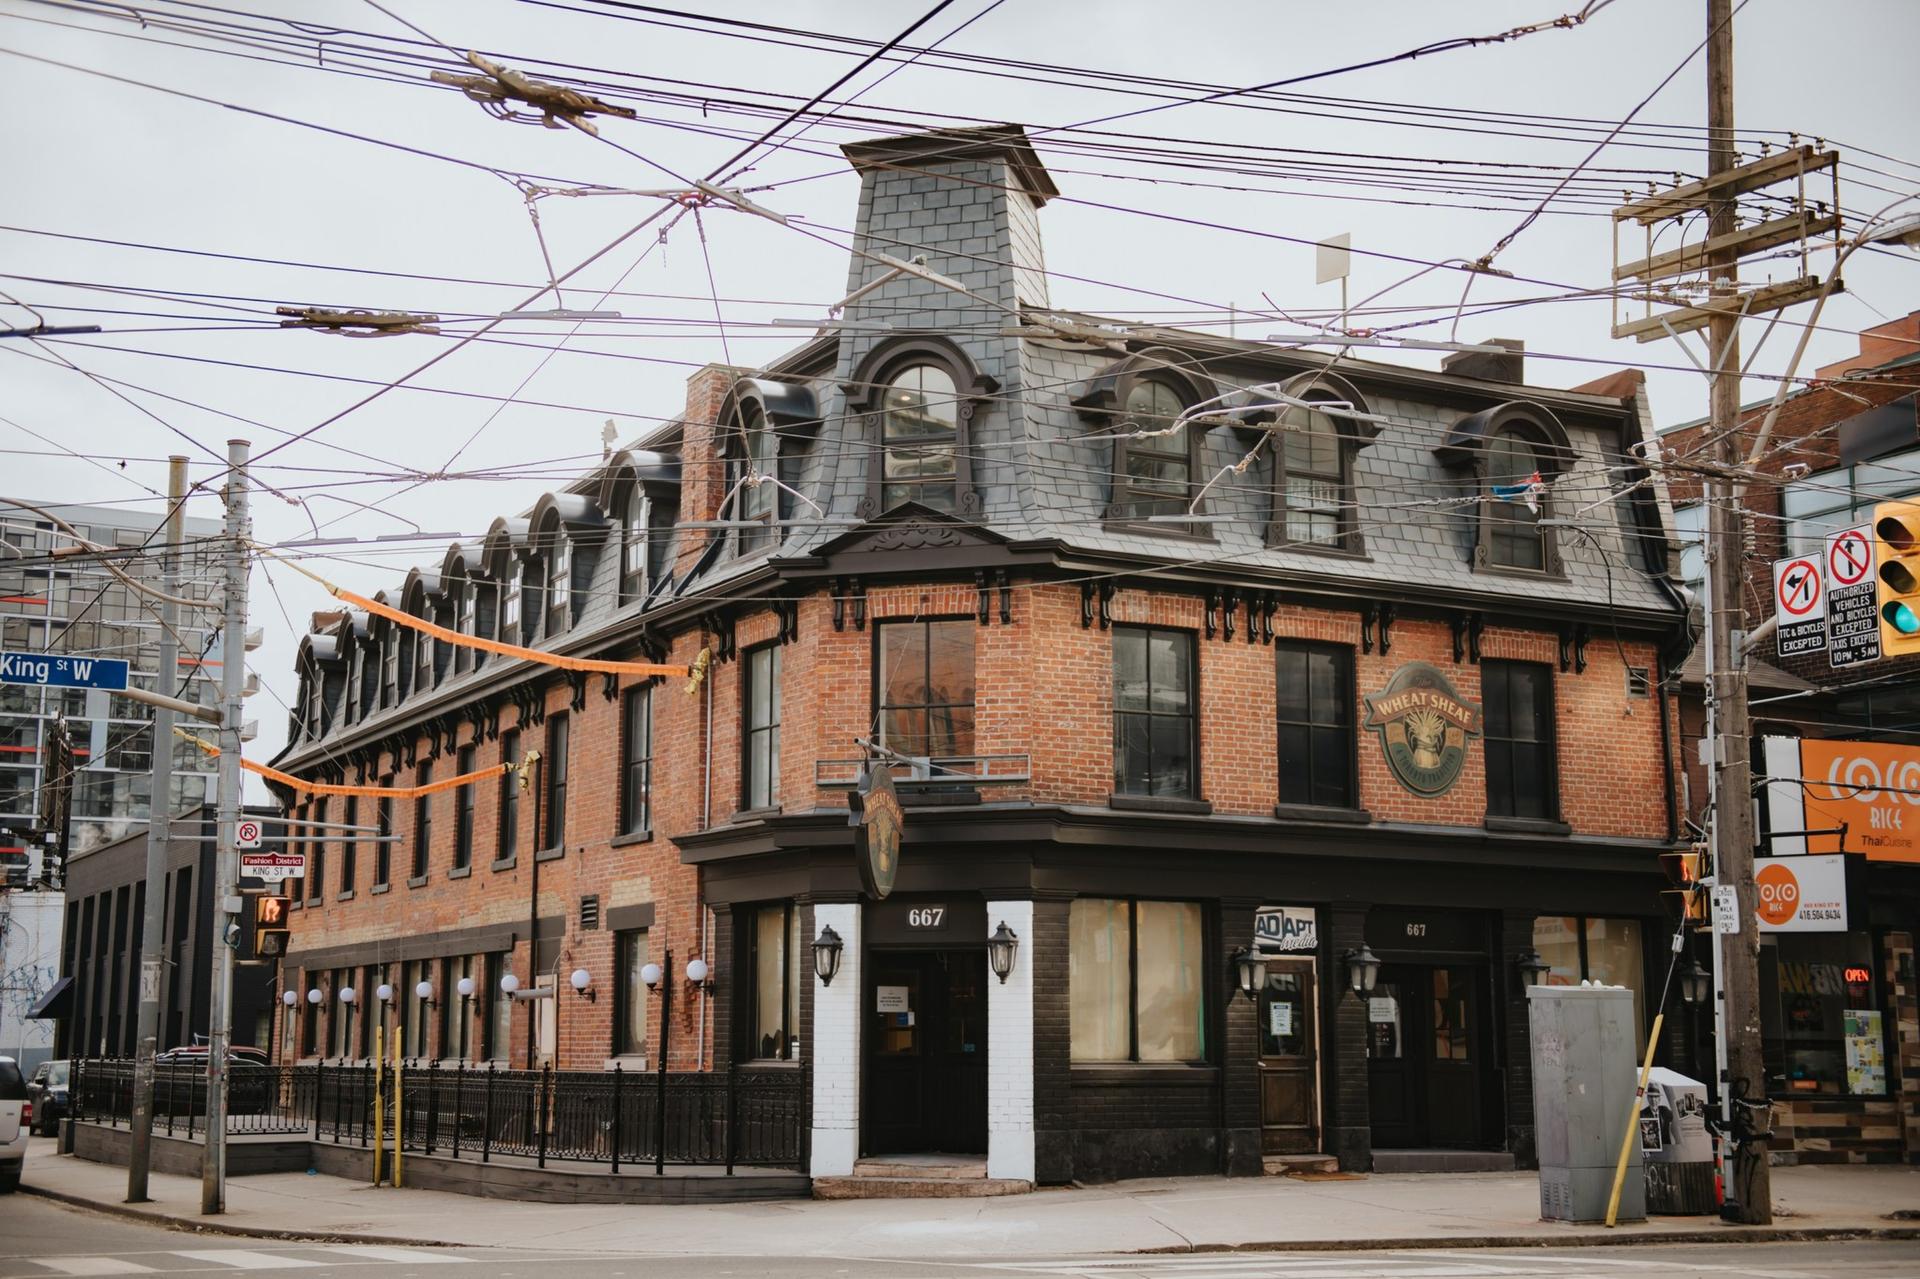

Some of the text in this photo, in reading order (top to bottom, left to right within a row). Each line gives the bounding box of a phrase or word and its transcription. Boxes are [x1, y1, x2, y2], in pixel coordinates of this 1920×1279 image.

[1830, 583, 1875, 601] AUTHORIZED
[1835, 595, 1870, 611] VEHICLES
[1830, 605, 1877, 625] AND BICYCLES
[1779, 622, 1826, 639] TTC & BICYCLES
[1835, 619, 1873, 635] EXCEPTED
[1783, 635, 1823, 652] EXCEPTED
[1831, 632, 1879, 650] TAXIS EXCEPTED
[0, 655, 92, 683] King St W
[1377, 692, 1472, 723] WHEAT SHEAF
[1870, 807, 1903, 831] RICE
[244, 857, 302, 866] Fashion District
[253, 867, 296, 876] KING ST W
[1759, 883, 1797, 902] OCO
[1769, 902, 1784, 912] RICE
[908, 908, 944, 927] 667
[1256, 915, 1313, 938] ADAPT
[1406, 923, 1427, 937] 667
[1280, 933, 1318, 951] media
[1845, 968, 1869, 982] OPEN
